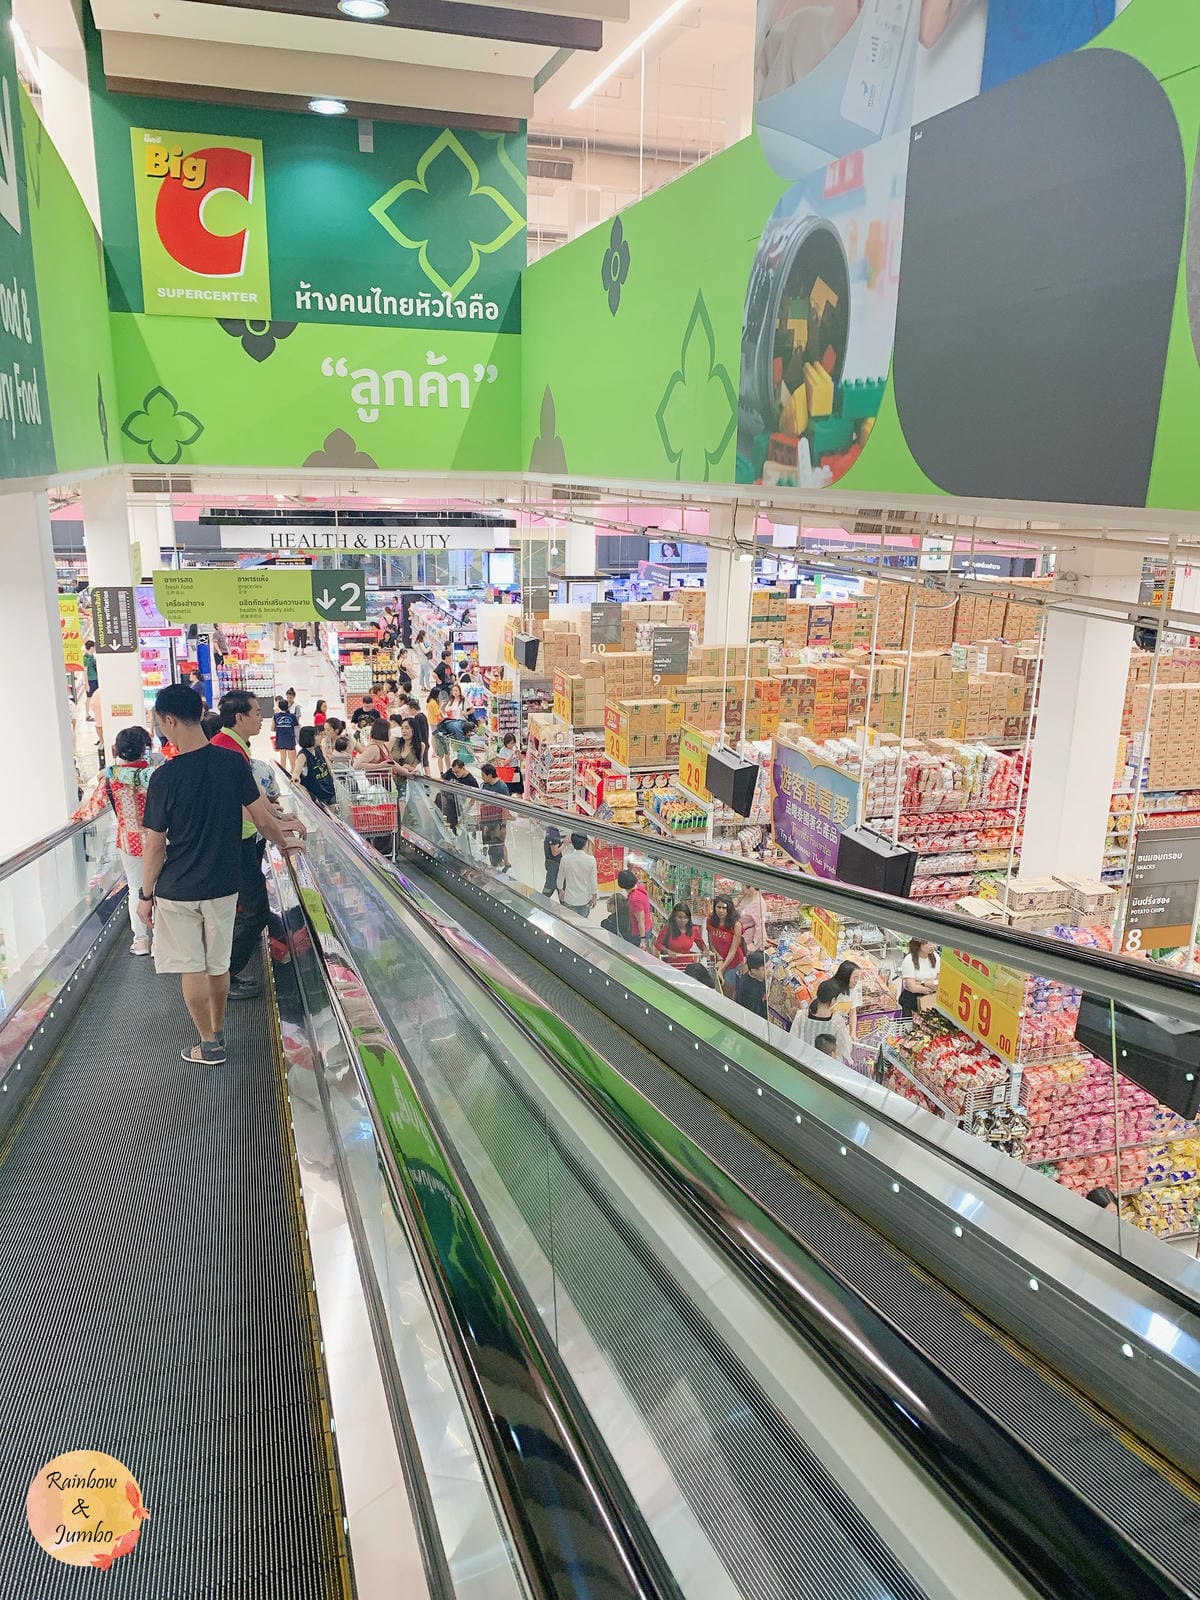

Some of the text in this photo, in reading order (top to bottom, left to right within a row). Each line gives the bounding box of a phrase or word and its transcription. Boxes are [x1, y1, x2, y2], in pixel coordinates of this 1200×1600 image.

[145, 145, 256, 279] Big C
[157, 287, 259, 303] SUPERCENTER
[294, 280, 500, 321] ห้างคนไทยหัวใจคือ
[21, 287, 33, 345] &
[13, 361, 42, 425] Food
[270, 533, 452, 549] HEALTH & BEAUTY
[340, 581, 362, 612] 2
[591, 643, 606, 655] 10
[652, 674, 661, 687] 9
[686, 762, 700, 792] 29
[1130, 908, 1150, 916] POTATO
[1125, 928, 1143, 952] 8
